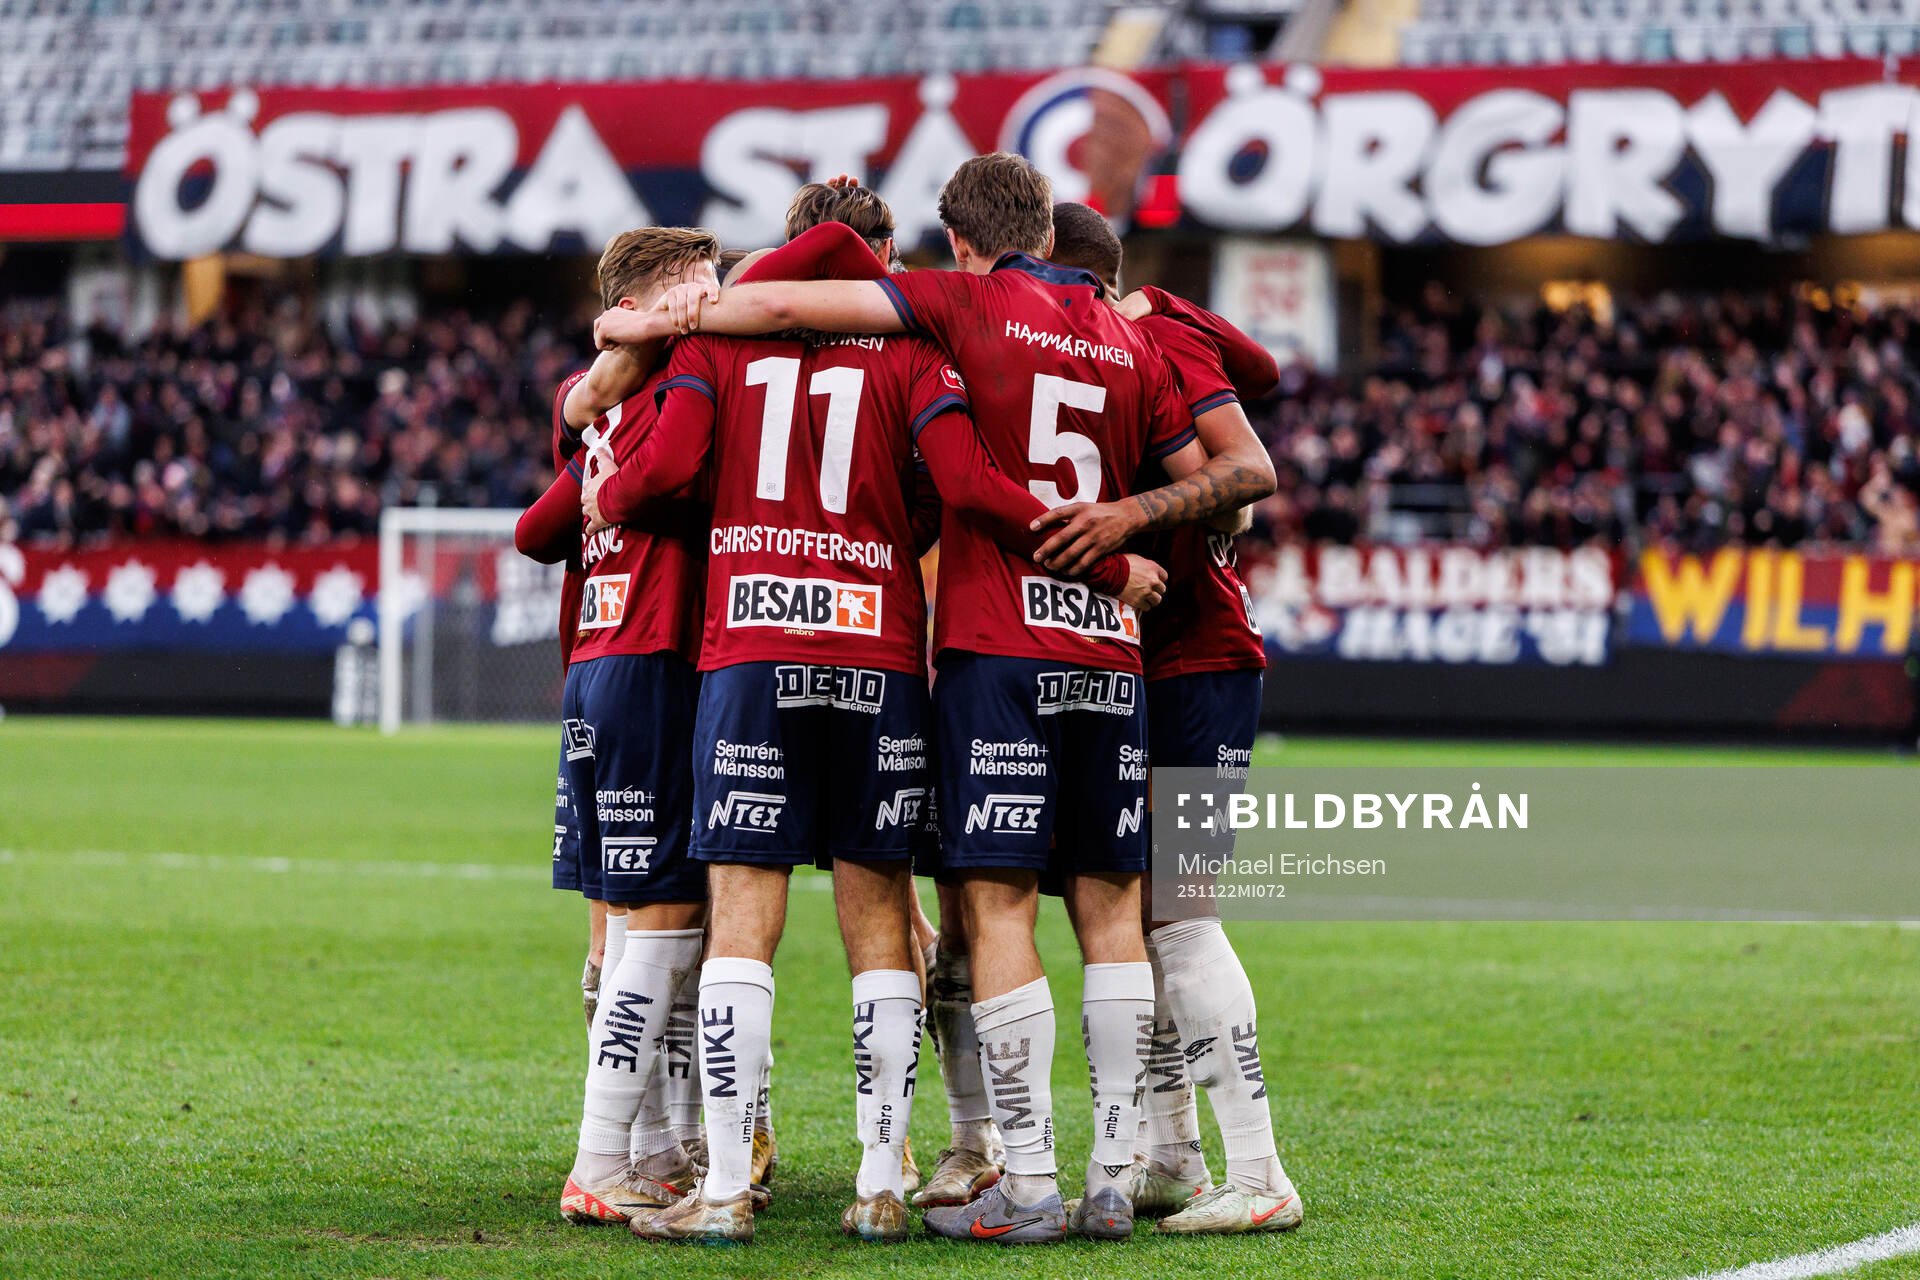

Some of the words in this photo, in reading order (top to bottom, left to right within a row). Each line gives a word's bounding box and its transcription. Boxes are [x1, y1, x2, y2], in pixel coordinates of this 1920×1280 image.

[135, 88, 652, 260] ÖSTRA
[1178, 63, 1920, 247] ÖRGRYT
[745, 357, 864, 514] 11
[1028, 373, 1107, 512] 5
[711, 525, 893, 571] CHRISTOFFERSSON
[732, 580, 832, 624] BESAB
[1027, 582, 1122, 632] BESAB
[783, 627, 815, 637] umbro
[849, 703, 881, 715] GROUP
[1105, 704, 1134, 717] GROUP
[713, 757, 785, 780] Månsson
[715, 739, 785, 761] Semrén+
[969, 756, 1047, 777] Månsson
[970, 738, 1049, 758] Semrén+
[596, 785, 655, 804] emrén+
[598, 990, 654, 1073] MIKE
[701, 1006, 738, 1098] MIKE
[854, 1003, 875, 1095] MIKE
[1231, 1022, 1266, 1100] MIKE
[985, 1037, 1036, 1130] MIKE
[741, 1102, 754, 1143] umbro
[876, 1104, 892, 1144] umbro
[1042, 1117, 1052, 1150] umbro
[1104, 1104, 1120, 1139] umbro
